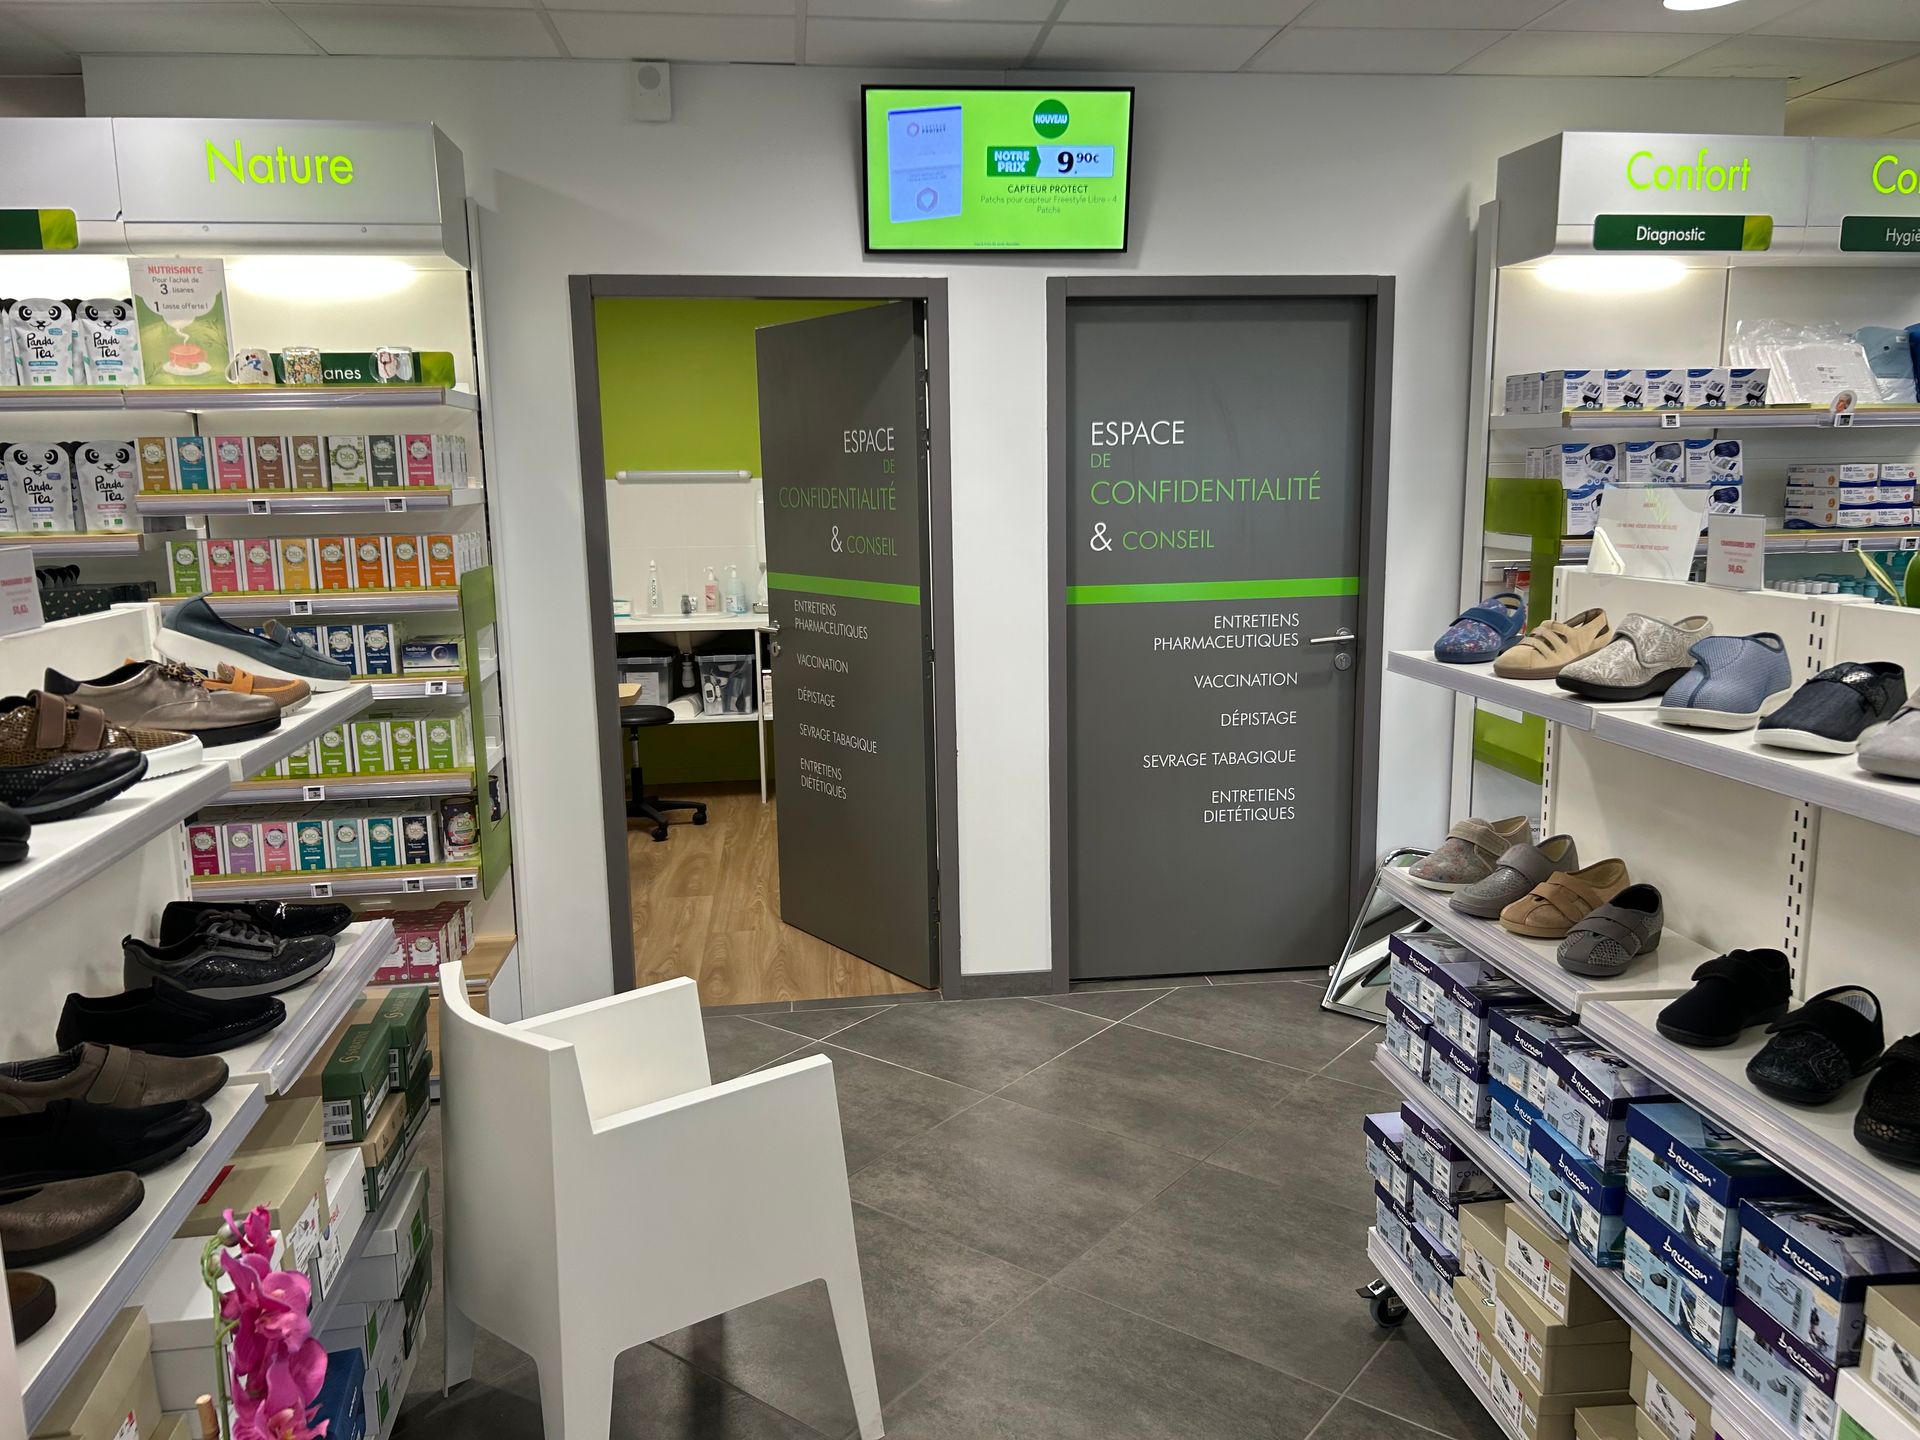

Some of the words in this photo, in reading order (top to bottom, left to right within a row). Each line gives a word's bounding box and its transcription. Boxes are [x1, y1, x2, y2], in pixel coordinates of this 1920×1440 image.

[1035, 114, 1068, 125] NOUVEAU
[205, 138, 354, 185] Nature
[994, 151, 1030, 162] NOTRE
[997, 161, 1026, 173] PRIX
[1626, 148, 1751, 193] Confort
[1872, 154, 1920, 195] Co
[980, 195, 1004, 204] Patchs
[1006, 197, 1022, 205] pour
[1024, 196, 1052, 205] capteur
[1053, 195, 1087, 204] Freestyle
[1088, 195, 1106, 203] Libre
[1007, 185, 1046, 194] CAPTEUR
[1049, 185, 1089, 194] PROTECT
[1036, 206, 1061, 214] Patchs
[1636, 225, 1706, 246] Diagnostic
[160, 283, 169, 295] 3
[172, 286, 195, 294] tisanes
[169, 276, 190, 284] l'achat
[153, 301, 160, 313] 1
[162, 303, 181, 311] tasse
[181, 301, 204, 311] offerte
[26, 332, 55, 348] Panda
[93, 331, 121, 348] Panda
[31, 346, 55, 359] Tea
[98, 345, 120, 358] Tea
[323, 367, 362, 380] anes
[843, 427, 895, 454] ESPACE
[1090, 420, 1185, 447] ESPACE
[883, 458, 896, 474] DE
[1090, 453, 1111, 469] DE
[23, 476, 53, 494] Panda
[95, 475, 125, 491] Panda
[1090, 470, 1321, 505] CONFIDENTIALITÉ
[29, 492, 54, 505] Tea
[100, 489, 125, 502] Tea
[779, 481, 897, 511] CONFIDENTIALITÉ
[830, 525, 843, 553] &
[846, 535, 897, 557] CONSEIL
[1090, 521, 1112, 552] &
[1122, 529, 1215, 551] CONSEIL
[794, 600, 837, 617] ENTRETIENS
[794, 617, 868, 640] PHARMACEUTIQUES
[1214, 613, 1300, 630] ENTRETIENS
[1153, 633, 1299, 651] PHARMACEUTIQUES
[797, 653, 849, 674] VACCINATION
[1193, 672, 1298, 689] VACCINATION
[797, 685, 836, 708] DÉPISTAGE
[1221, 709, 1297, 727] DÉPISTAGE
[799, 723, 831, 743] SEVRAGE
[832, 731, 878, 754] TABAGIQUE
[800, 757, 843, 781] ENTRETIENS
[1143, 752, 1207, 769] SEVRAGE
[1211, 749, 1296, 766] TABAGIQUE
[801, 773, 847, 800] DIÉTÉTIQUES
[1211, 787, 1296, 804] ENTRETIENS
[1204, 805, 1295, 823] DIETÉTIQUES
[1408, 951, 1432, 974] bruman
[1452, 984, 1475, 1009] bruman
[1401, 1008, 1421, 1033] bruman
[1514, 1030, 1544, 1059] bruman
[1449, 1047, 1473, 1074] bruman
[1571, 1071, 1604, 1108] bruman
[1513, 1098, 1533, 1126] brum
[1421, 1124, 1445, 1152] bruman
[1381, 1137, 1402, 1164] bruman
[1558, 1153, 1592, 1195] bruman
[1667, 1142, 1713, 1188] bruman
[1392, 1201, 1412, 1228] bruman
[1429, 1249, 1452, 1281] bruman
[1662, 1235, 1709, 1285] bruman
[1781, 1238, 1831, 1286] bruman
[1778, 1331, 1826, 1384] bruman
